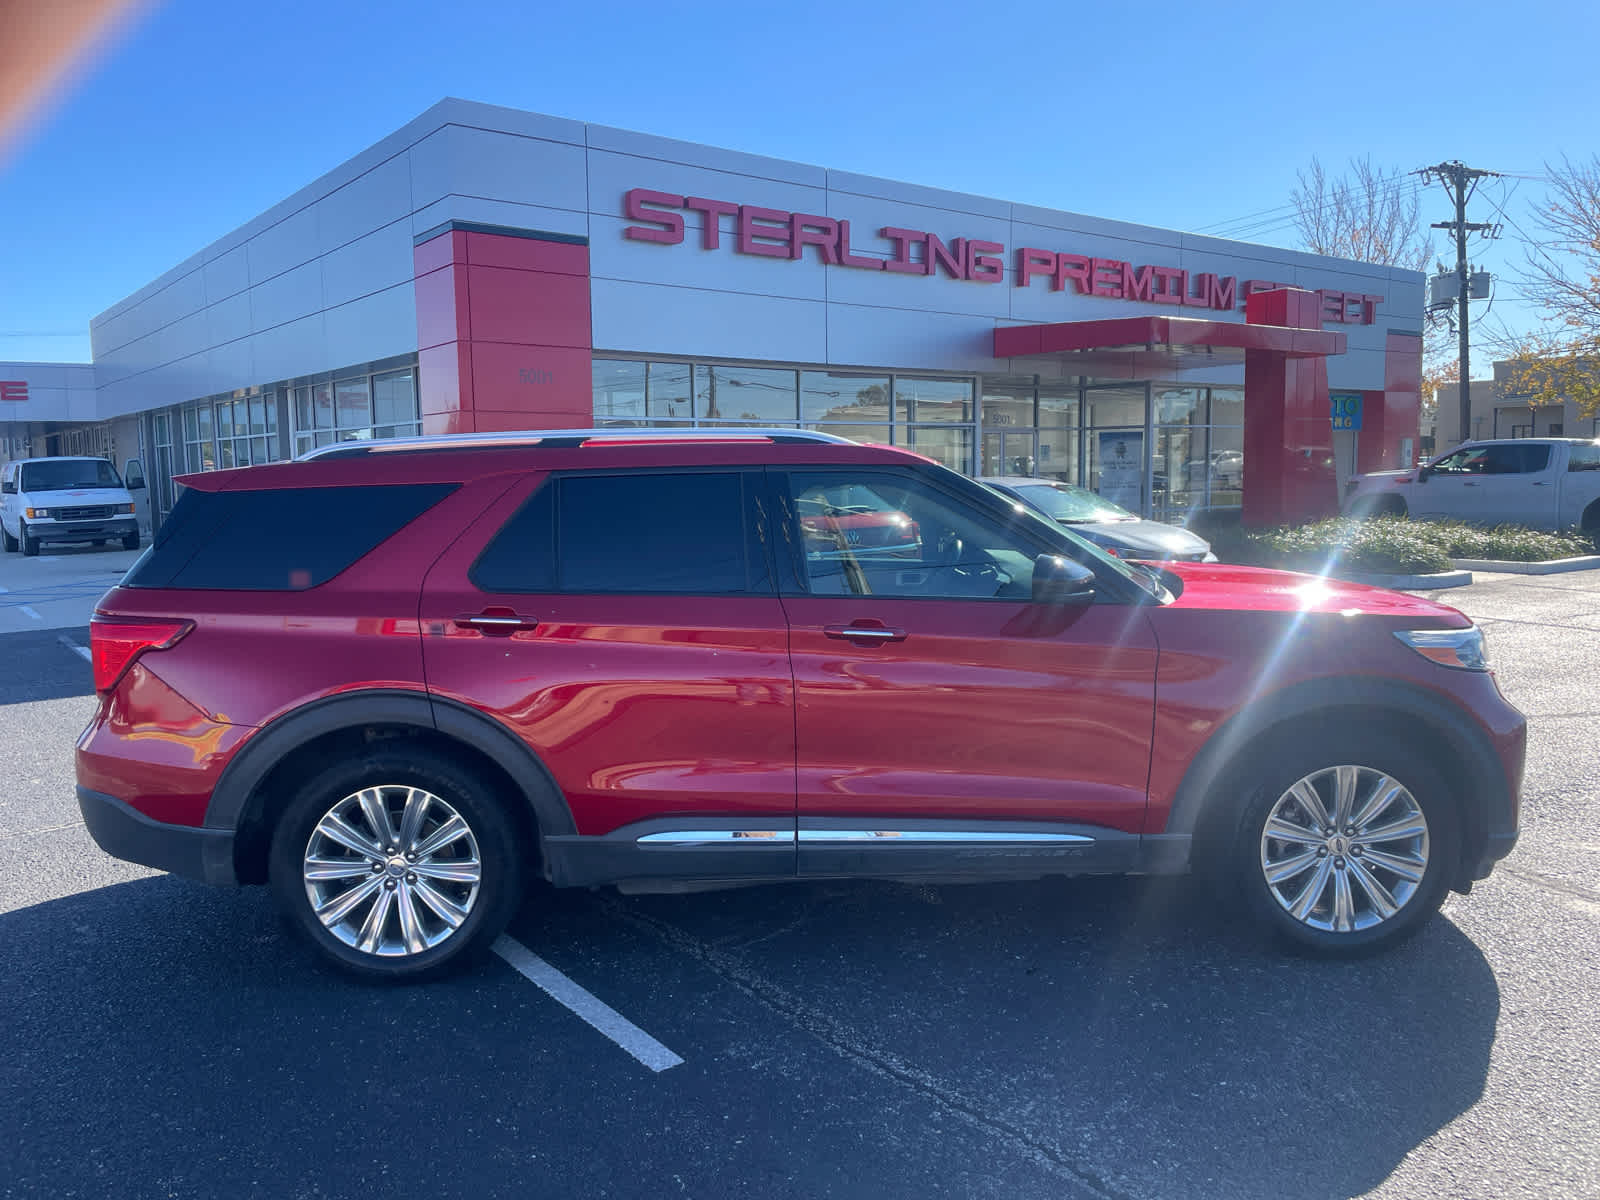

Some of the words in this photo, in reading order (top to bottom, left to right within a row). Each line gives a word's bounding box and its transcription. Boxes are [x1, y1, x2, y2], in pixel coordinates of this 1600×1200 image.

[624, 187, 1004, 284] STERLING
[1017, 247, 1237, 311] PREMIUM
[1240, 279, 1385, 326] ECT
